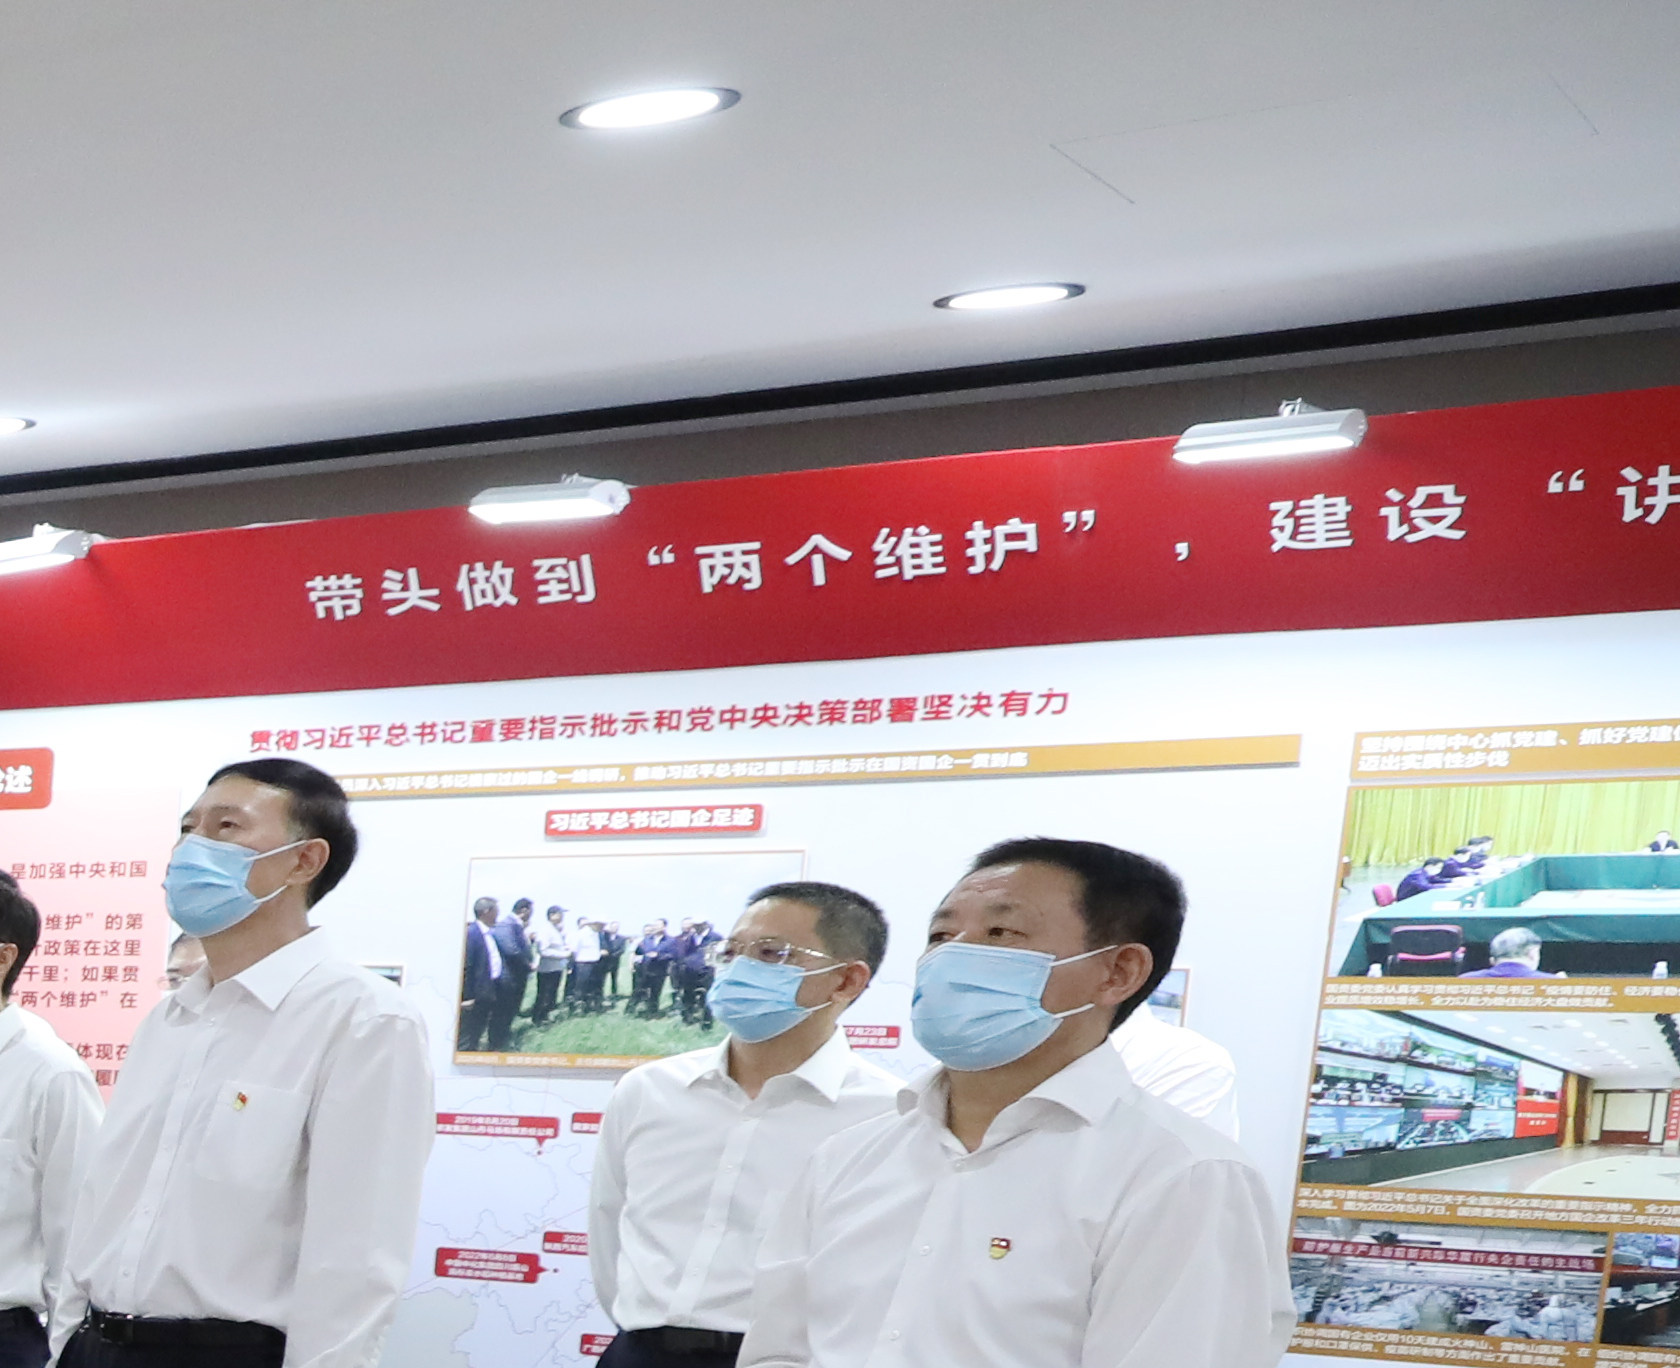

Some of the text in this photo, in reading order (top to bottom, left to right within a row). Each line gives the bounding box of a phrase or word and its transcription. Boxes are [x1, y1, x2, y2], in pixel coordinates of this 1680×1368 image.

[248, 687, 1070, 753] 贯彻习近平总书记重要指示批示和党中央决策部署坚决有力
[1356, 750, 1511, 772] 迈出实质性步伐
[548, 806, 756, 833] 习近平总书记国企足迹
[10, 860, 148, 880] 是加强中央和国
[72, 1042, 131, 1061] 体现在
